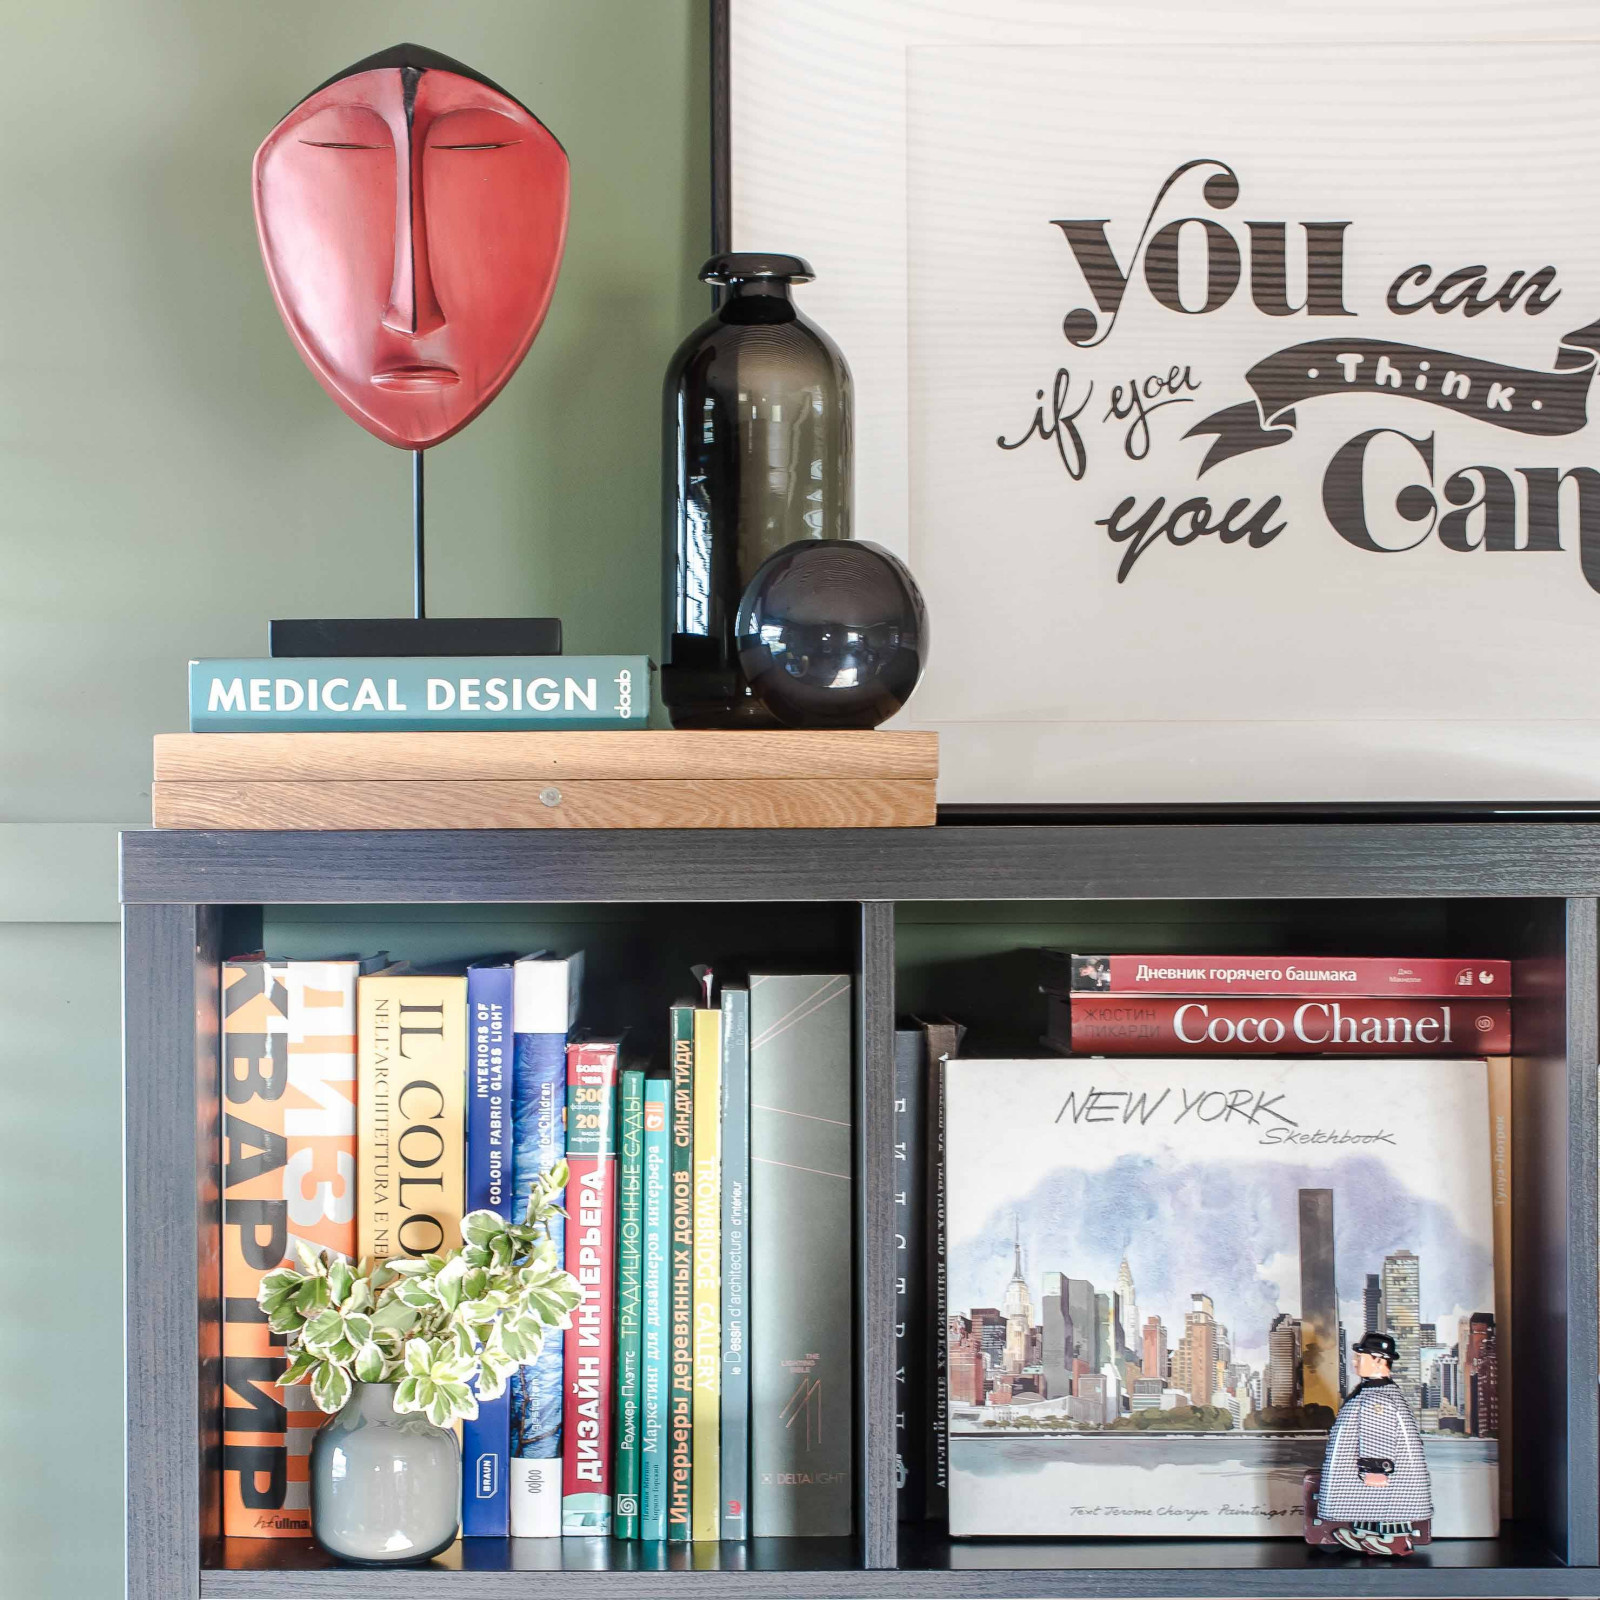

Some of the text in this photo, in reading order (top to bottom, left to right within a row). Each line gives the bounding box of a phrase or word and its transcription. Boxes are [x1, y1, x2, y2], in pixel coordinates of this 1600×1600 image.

[1049, 158, 1562, 348] you can
[997, 366, 1201, 480] if you
[1095, 494, 1288, 584] you
[207, 677, 598, 712] MEDICAL DESIGN
[614, 669, 632, 719] daab
[1083, 1008, 1157, 1022] ЖЮСТИН
[1135, 964, 1358, 985] Дневник горячего башмака
[477, 1002, 490, 1098] INTERIORS OF
[1084, 1024, 1161, 1039] ПИКАРДИ
[1173, 1002, 1453, 1045] Coco Chanel
[398, 999, 444, 1258] IL COLO
[489, 1003, 503, 1205] COLOUR FABRIC GLASS LIGHT
[537, 1082, 552, 1129] Children
[538, 1132, 551, 1147] for
[674, 1040, 692, 1148] СИНДИ ТИДИ
[1055, 1086, 1300, 1127] NEW YORK
[1258, 1126, 1398, 1146] Sketchbook
[223, 963, 288, 1511] КВАРТИР
[373, 1211, 389, 1223] E
[578, 1170, 604, 1348] ИНТЕРЬЕРА
[621, 1096, 643, 1339] ТРАДИЦИОННЫЕ САДЫ
[643, 1145, 661, 1453] Маркетинг для дизайнеров интерьера
[696, 1156, 716, 1392] TROWBRIDGE GALLERY
[723, 1180, 743, 1376] le Dessin d'architecture d'intérieur
[673, 1249, 693, 1393] деревянных
[528, 1378, 542, 1432] gestalten
[573, 1357, 603, 1483] ДИЗАЙН
[482, 1459, 492, 1492] BRAUN
[670, 1394, 693, 1524] Интерьеры
[1069, 1505, 1101, 1517] Text
[1103, 1505, 1152, 1517] Jerome
[1156, 1504, 1210, 1522] Charyn
[1217, 1504, 1288, 1520] Paintings
